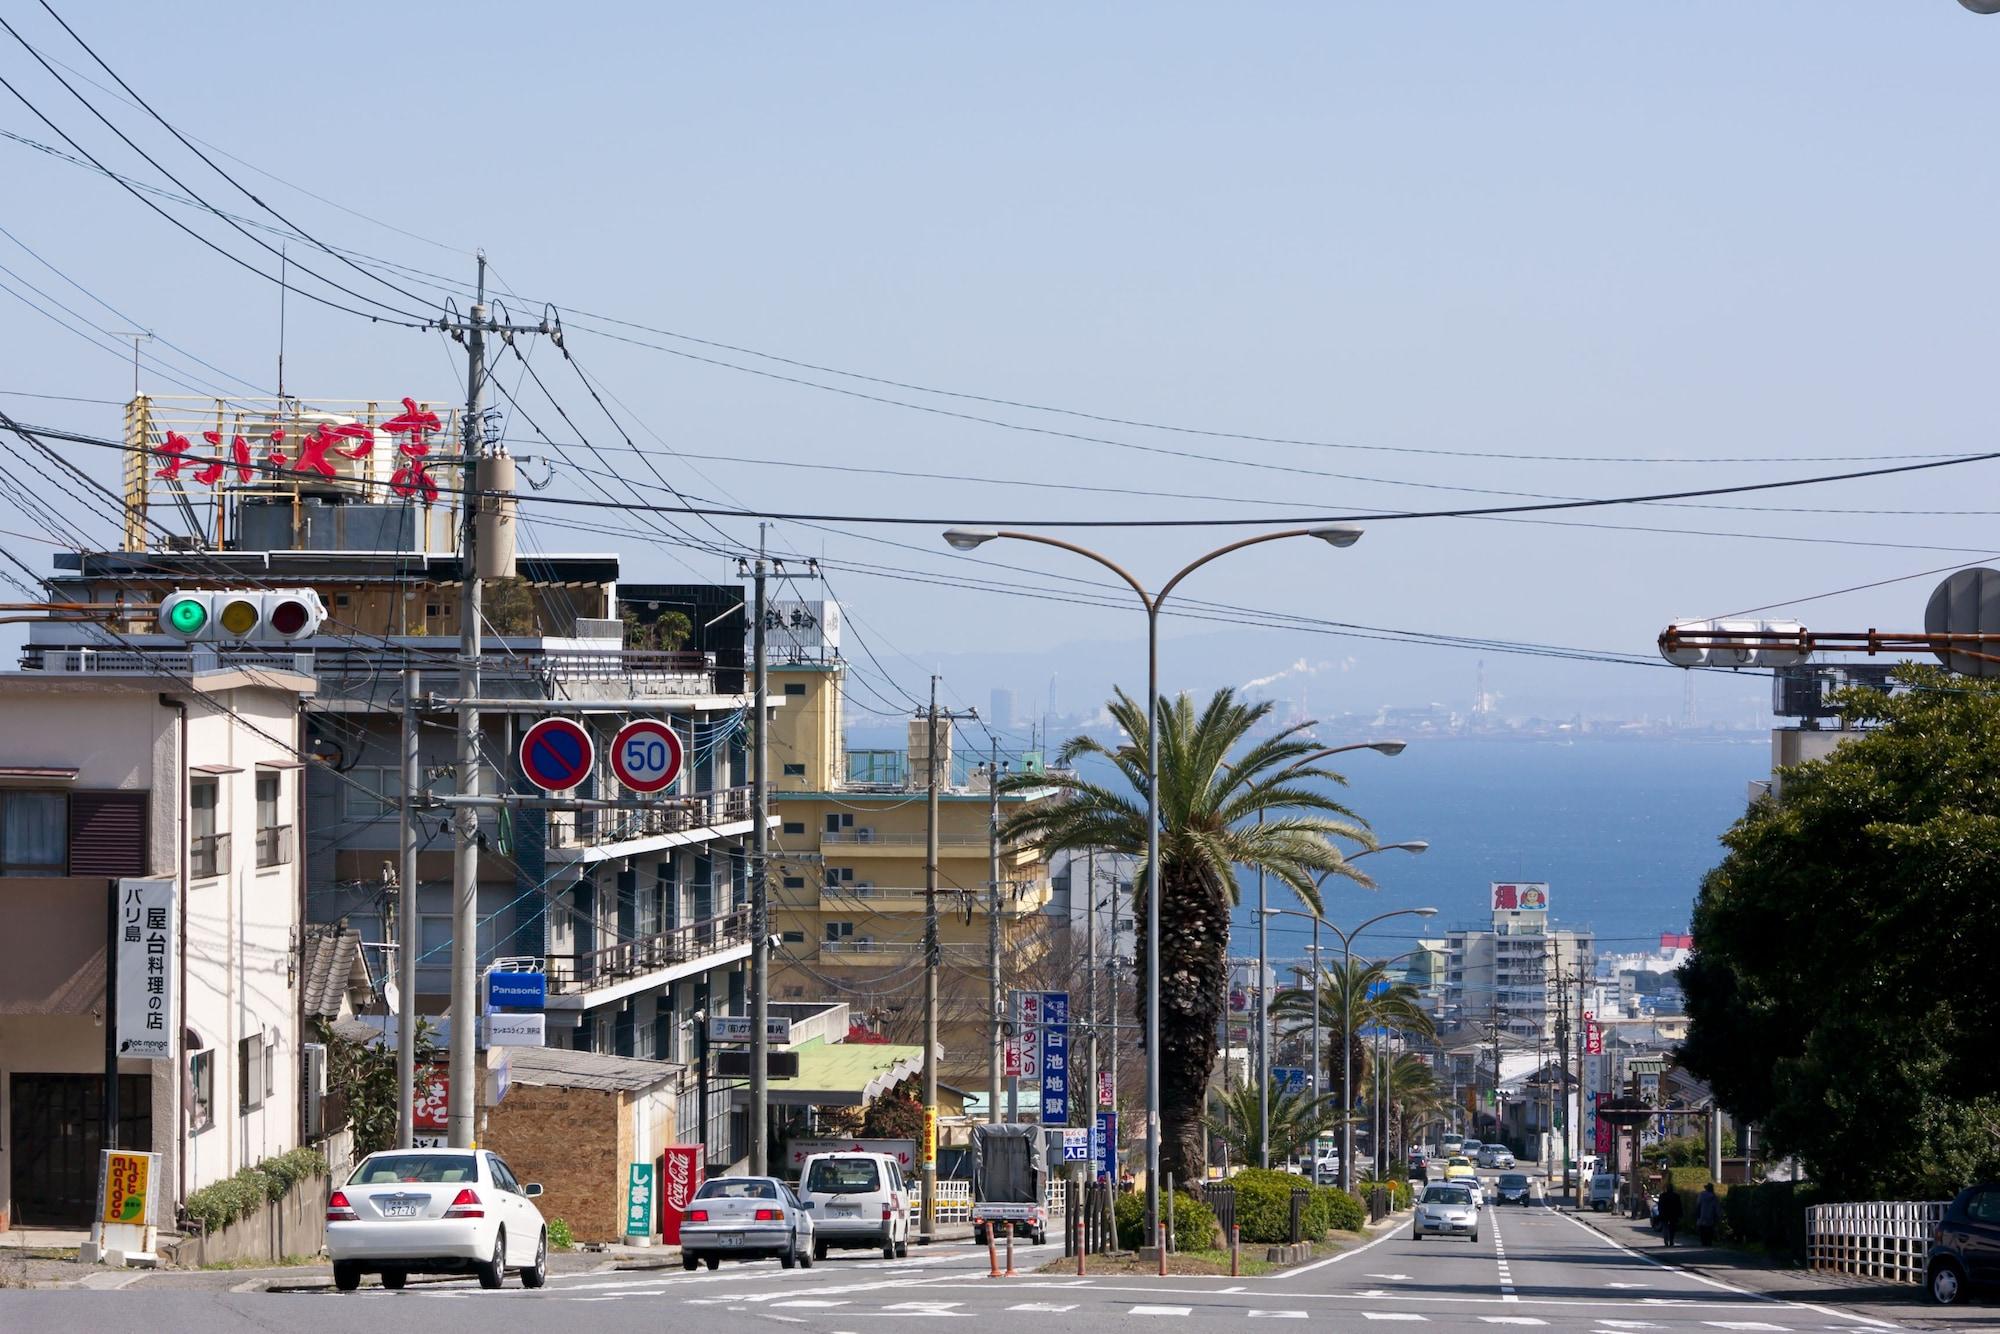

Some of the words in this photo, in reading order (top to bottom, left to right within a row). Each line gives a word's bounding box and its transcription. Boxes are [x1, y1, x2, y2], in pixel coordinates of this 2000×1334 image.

[627, 740, 665, 772] 50
[125, 889, 142, 942] バリ島
[146, 907, 166, 1030] 屋台料理の店
[492, 985, 541, 995] Panasonic
[1046, 1032, 1064, 1114] 白池地獄
[1065, 1148, 1087, 1159] 入口
[668, 1151, 689, 1212] Coca-Cola
